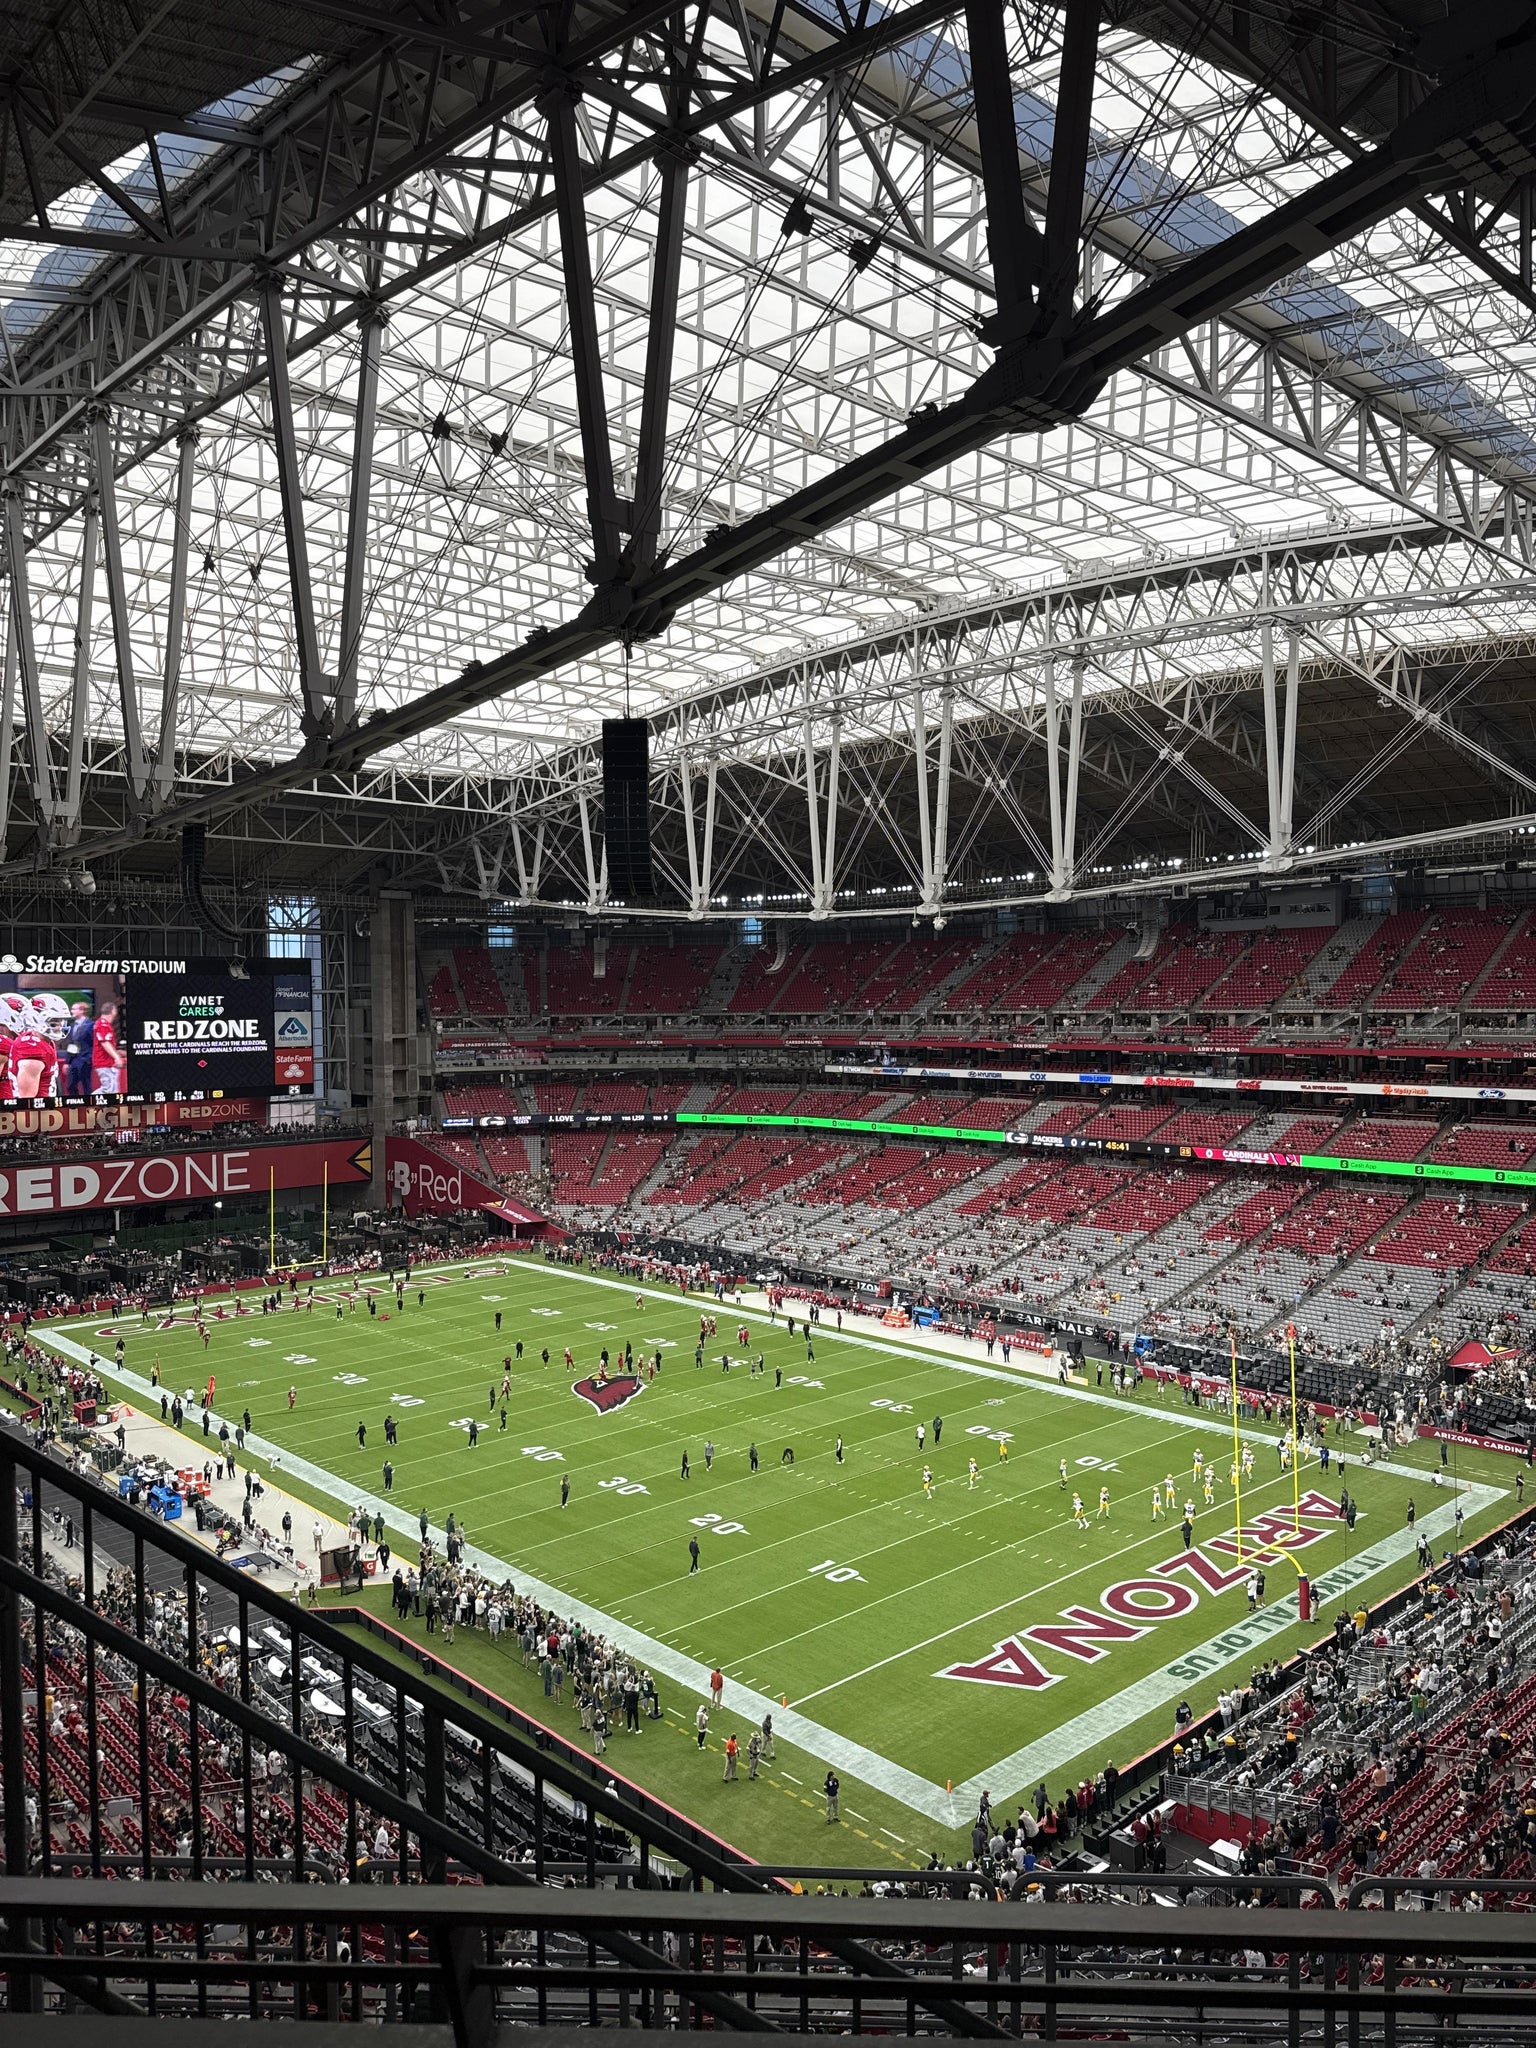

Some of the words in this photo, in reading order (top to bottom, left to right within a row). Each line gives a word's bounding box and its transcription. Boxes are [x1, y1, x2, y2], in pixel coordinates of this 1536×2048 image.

[120, 961, 186, 974] STADIUM
[180, 996, 224, 1005] AVNET
[180, 1007, 215, 1016] CARES
[144, 1020, 259, 1040] REDZONE
[1030, 1073, 1046, 1081] COX
[1483, 1089, 1504, 1098] Ford
[0, 1110, 63, 1134] BUD
[69, 1104, 160, 1131] LIGHT
[180, 1104, 250, 1119] REDZONE
[1033, 1135, 1063, 1144] PACKERS
[1070, 1138, 1078, 1147] 0
[1105, 1140, 1130, 1151] 45:41
[1206, 1149, 1213, 1158] 0
[1223, 1150, 1269, 1161] CARDINALS
[1368, 1163, 1377, 1171] App
[1442, 1169, 1454, 1177] App
[1507, 1174, 1523, 1182] Cash
[282, 1353, 318, 1365] 20
[332, 1372, 369, 1385] 30
[785, 1375, 825, 1389] 40
[388, 1393, 426, 1408] 40
[869, 1398, 914, 1413] 30
[448, 1417, 490, 1433] 50
[965, 1425, 1015, 1441] 20
[1434, 1431, 1480, 1446] ARIZONA
[520, 1446, 559, 1462] 40
[1074, 1456, 1119, 1471] 10
[598, 1476, 648, 1495] 30
[688, 1513, 744, 1536] 20
[1353, 1555, 1387, 1571] IT
[807, 1559, 860, 1583] 10
[932, 1489, 1368, 1691] ARIZONA
[1241, 1605, 1297, 1634] ALL
[1210, 1633, 1253, 1658] OF
[1167, 1655, 1220, 1681] US
[1332, 1766, 1343, 1776] 84
[994, 1870, 1002, 1879] 10
